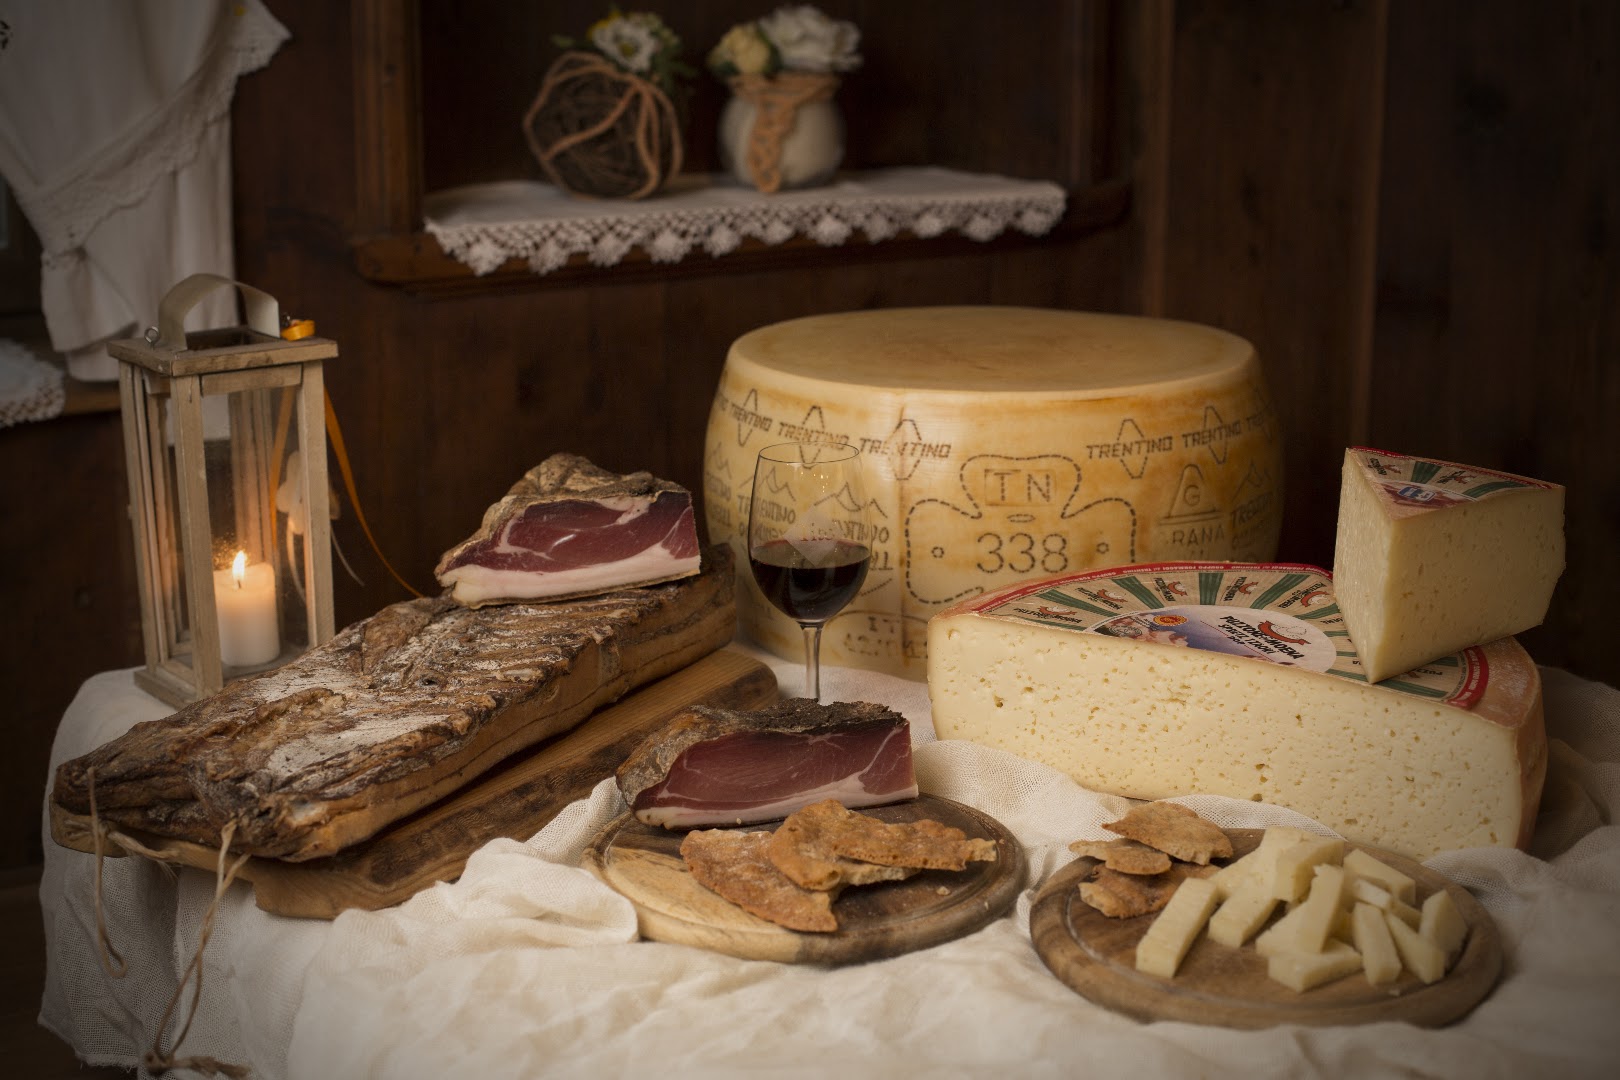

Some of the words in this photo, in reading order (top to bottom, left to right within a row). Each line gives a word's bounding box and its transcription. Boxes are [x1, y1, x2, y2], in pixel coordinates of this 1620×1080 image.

[731, 403, 773, 432] TRENTINO
[778, 422, 850, 450] TRENTINO
[1086, 436, 1173, 460] TRENTINO
[1182, 419, 1242, 449] TRENTINO
[977, 533, 1068, 573] 338
[1220, 615, 1264, 639] PUZZONE
[1264, 638, 1305, 660] MOENA
